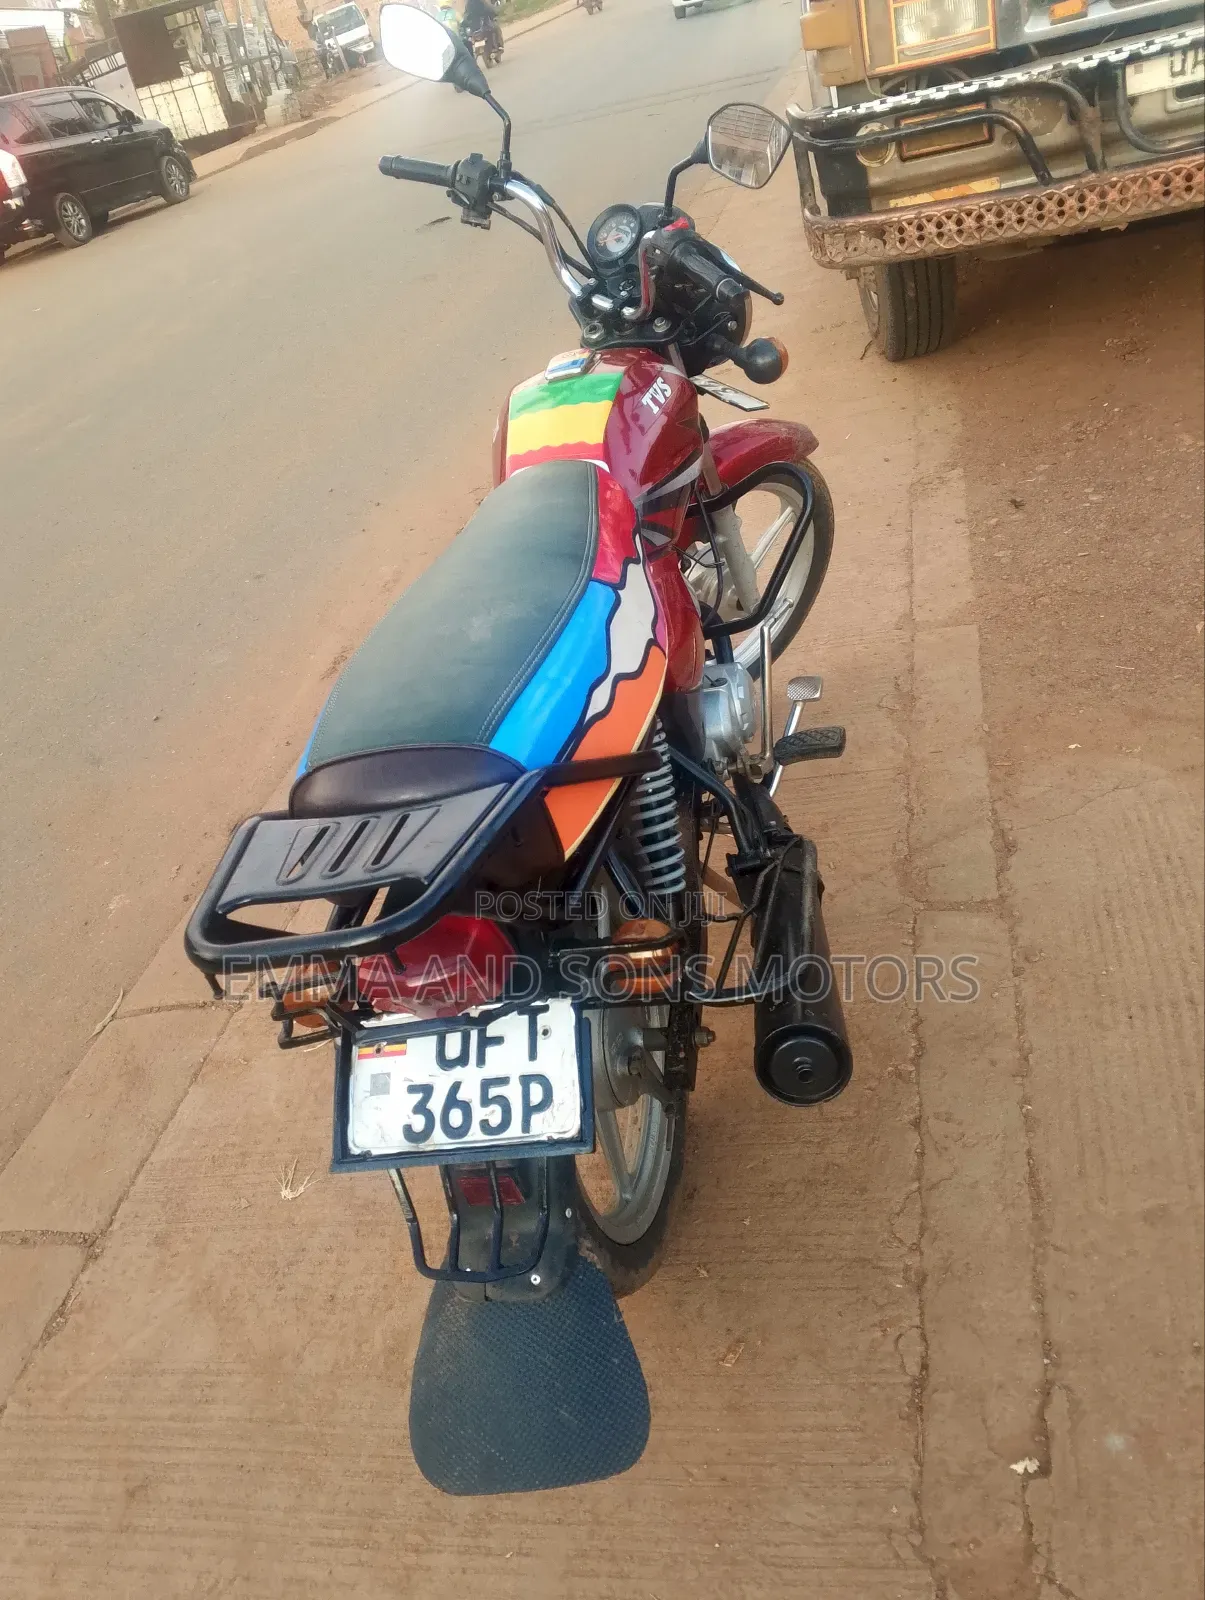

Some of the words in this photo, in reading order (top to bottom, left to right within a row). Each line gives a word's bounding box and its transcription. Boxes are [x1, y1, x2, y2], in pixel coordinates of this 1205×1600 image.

[641, 376, 672, 415] TVS
[435, 1004, 550, 1072] UFT
[402, 1073, 554, 1145] 365P
